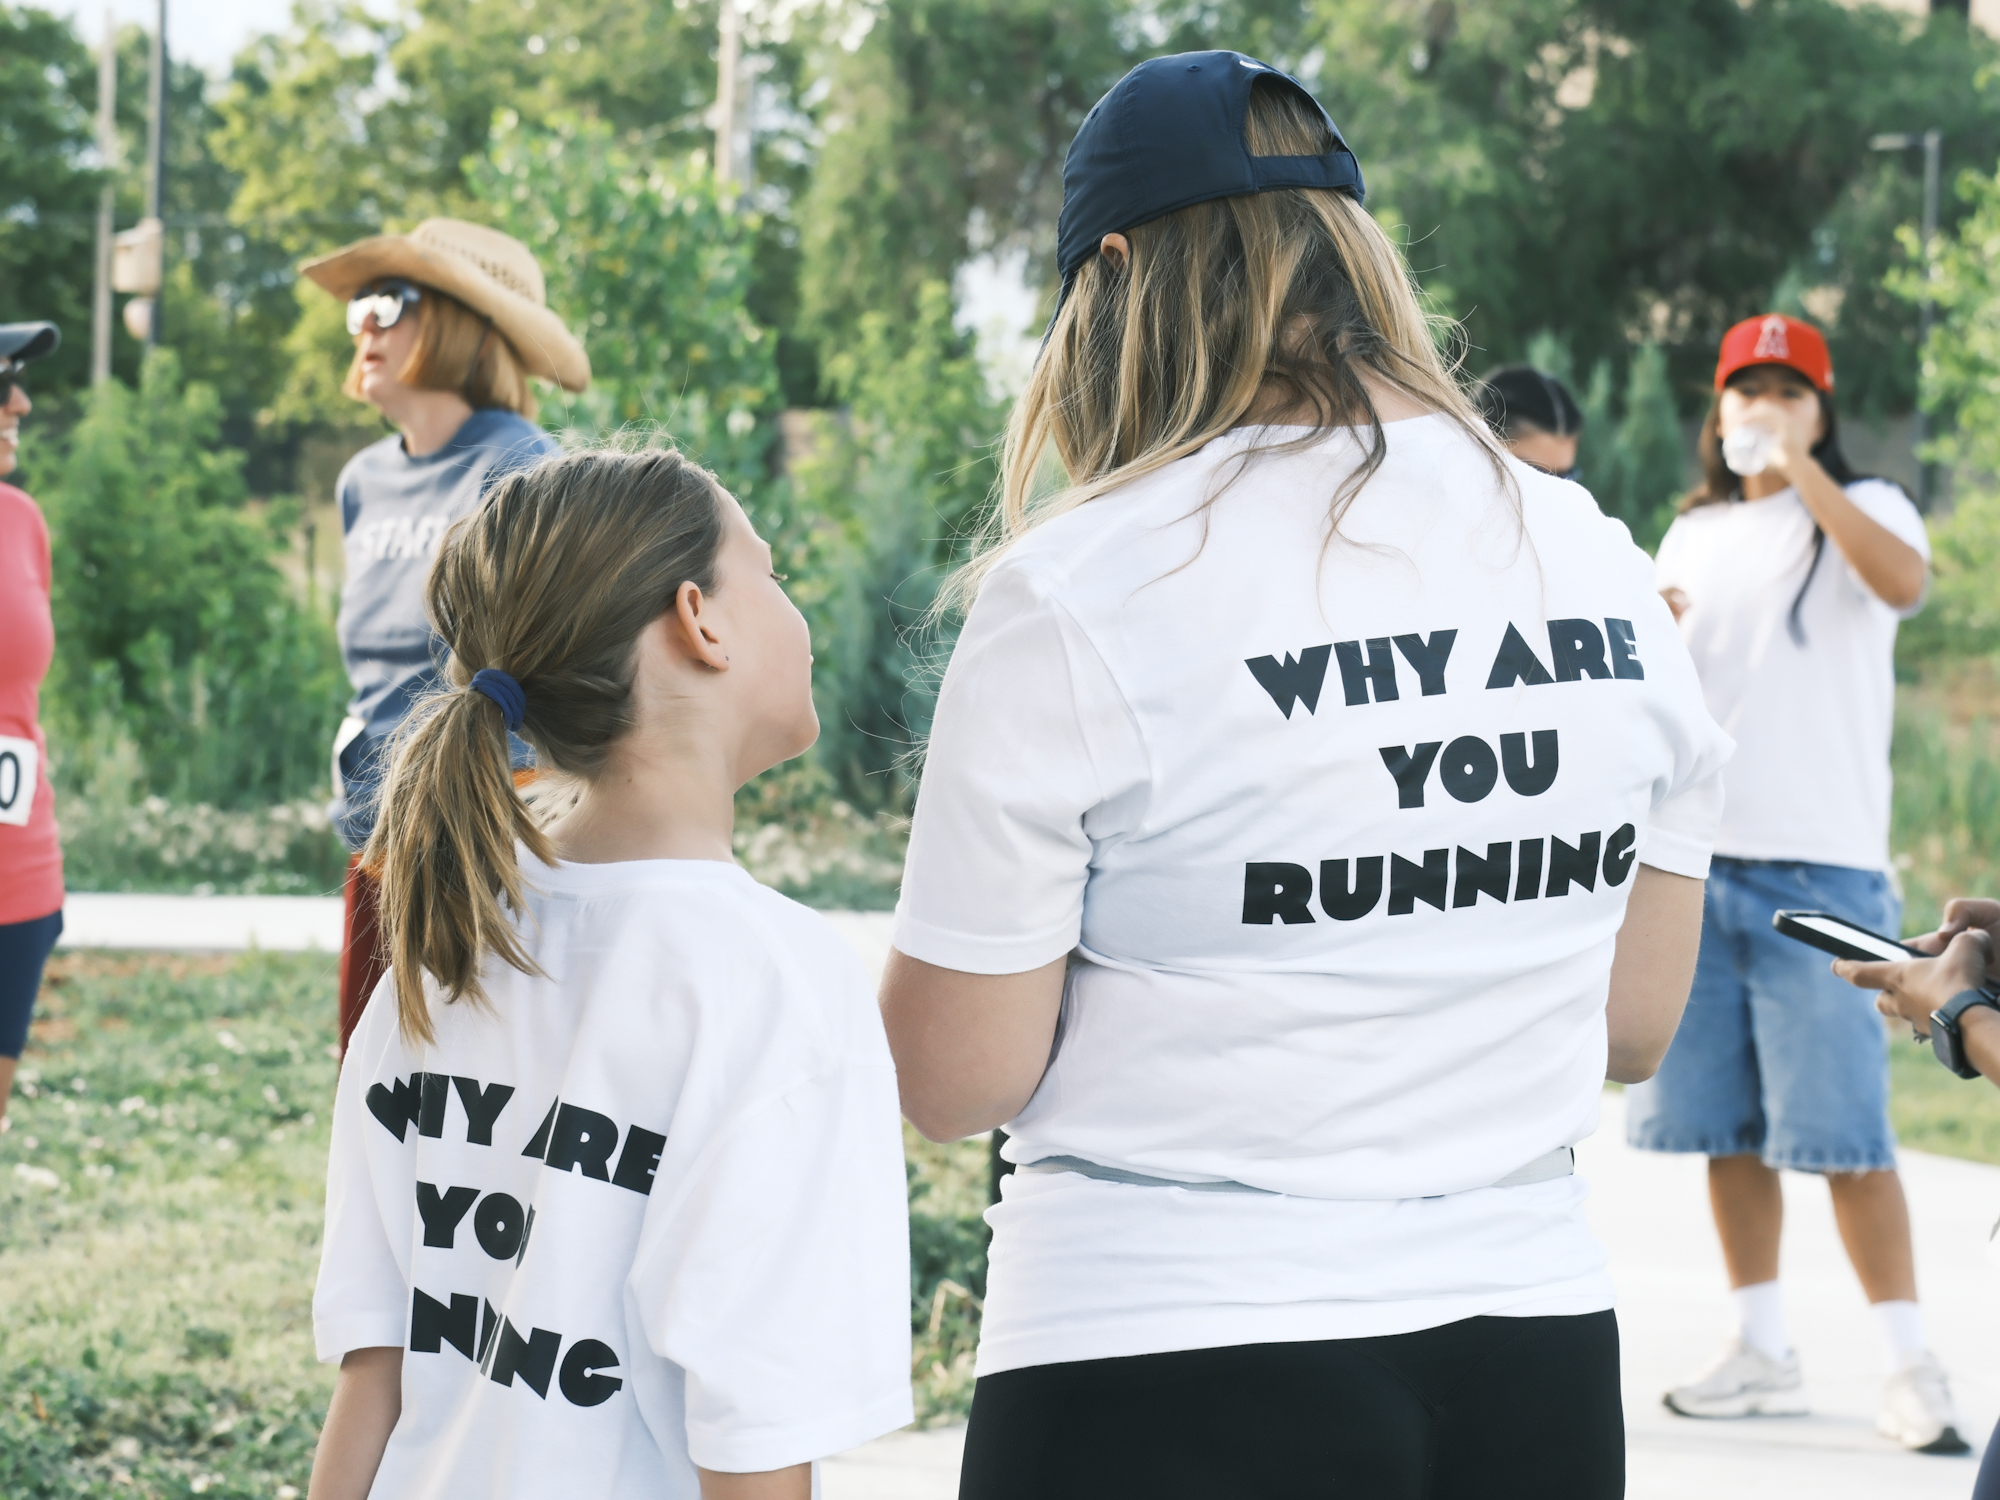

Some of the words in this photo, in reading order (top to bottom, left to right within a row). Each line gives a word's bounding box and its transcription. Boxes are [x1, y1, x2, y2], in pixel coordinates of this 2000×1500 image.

[1753, 315, 1790, 360] A
[1244, 628, 1459, 721] WHY
[1485, 617, 1645, 690] ARE
[1378, 729, 1559, 809] YOU
[1241, 822, 1637, 925] RUNNING
[416, 1180, 536, 1271] YO
